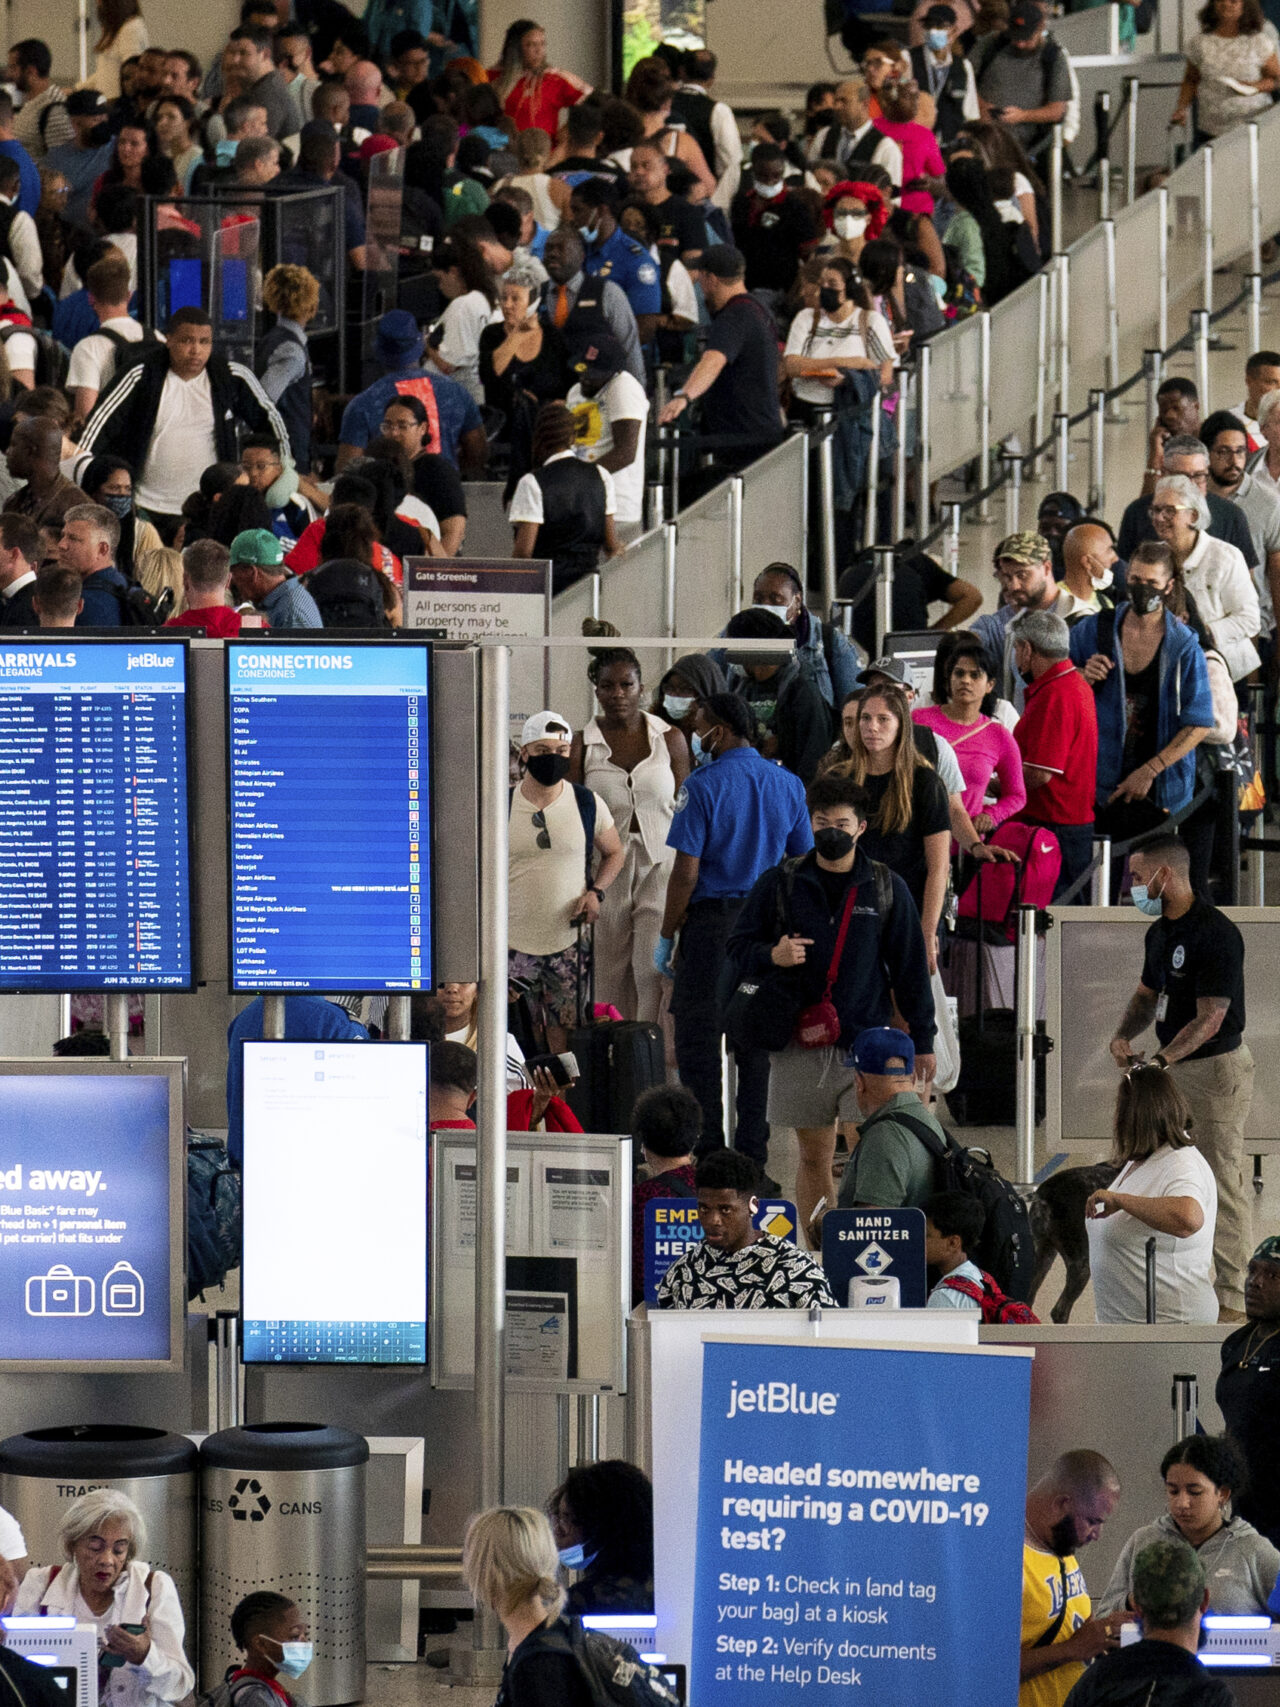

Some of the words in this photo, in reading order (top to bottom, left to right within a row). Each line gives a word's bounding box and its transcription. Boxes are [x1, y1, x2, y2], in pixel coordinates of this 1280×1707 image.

[415, 572, 435, 581] Gate
[436, 572, 478, 583] Screening
[415, 601, 430, 612] All
[433, 602, 477, 613] persons
[480, 602, 501, 613] and
[415, 616, 465, 628] property
[467, 617, 493, 629] may
[495, 617, 509, 628] be
[127, 653, 175, 670] jetBlue
[237, 655, 353, 669] CONNECTIONS
[237, 669, 296, 678] CONEXIONES
[29, 1170, 107, 1196] away.
[1, 1205, 21, 1216] Blue
[56, 1205, 77, 1216] fare
[78, 1207, 99, 1218] may
[655, 1209, 699, 1223] EMP
[27, 1219, 41, 1229] bin
[51, 1219, 57, 1229] 1
[59, 1219, 102, 1231] personal
[104, 1219, 126, 1229] item
[856, 1217, 892, 1228] HAND
[4, 1233, 19, 1245] pet
[58, 1233, 76, 1243] that
[78, 1233, 93, 1243] fits
[95, 1233, 123, 1243] under
[655, 1225, 705, 1241] LIQU
[838, 1230, 910, 1241] SANITIZER
[726, 1380, 839, 1418] jetBlue
[724, 1459, 822, 1486] Headed
[827, 1467, 981, 1493] somewhere
[56, 1485, 109, 1496] TRA
[279, 1501, 323, 1515] CANS
[722, 1495, 842, 1526] requiring
[848, 1502, 864, 1522] a
[869, 1498, 990, 1526] COVID-19
[721, 1526, 787, 1551] test?
[718, 1573, 760, 1595] Step
[765, 1574, 780, 1593] 1:
[784, 1575, 840, 1595] Check
[845, 1577, 861, 1596] in
[866, 1577, 904, 1598] (and
[909, 1581, 936, 1603] tag
[717, 1604, 757, 1622] your
[762, 1602, 800, 1625] bag)
[804, 1605, 821, 1622] at
[826, 1609, 837, 1622] a
[842, 1605, 888, 1624] kiosk
[716, 1635, 757, 1657] Step
[762, 1636, 778, 1655] 2:
[783, 1637, 834, 1661] Verify
[838, 1640, 937, 1660] documents
[715, 1665, 732, 1681] at
[737, 1664, 765, 1682] the
[771, 1665, 812, 1688] Help
[817, 1666, 862, 1686] Desk
